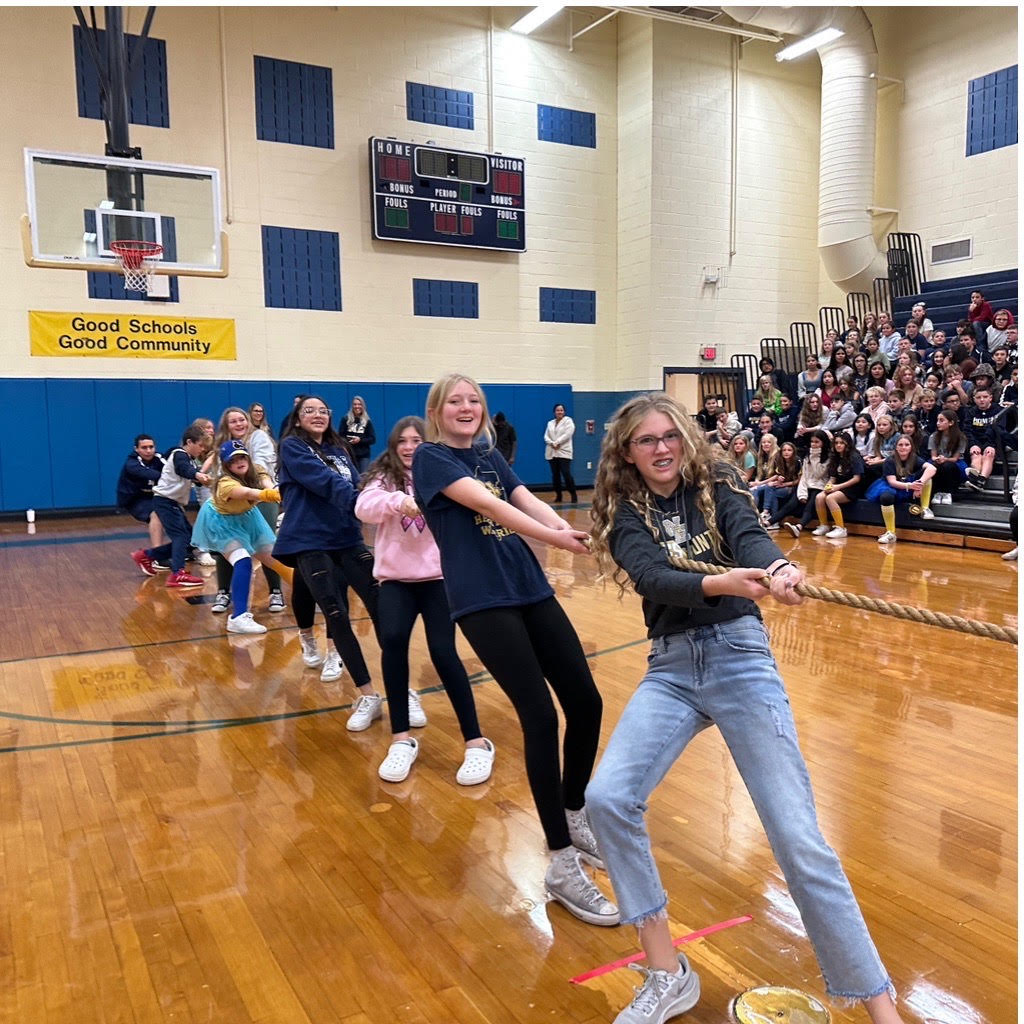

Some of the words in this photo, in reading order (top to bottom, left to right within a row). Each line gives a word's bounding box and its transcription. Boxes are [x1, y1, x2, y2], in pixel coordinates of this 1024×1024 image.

[377, 142, 411, 156] HOME
[490, 157, 523, 172] VISITOR
[389, 182, 414, 194] BONUS
[435, 188, 457, 199] PERIOD
[385, 197, 408, 208] FOULS
[490, 195, 513, 206] BONUS
[430, 202, 457, 214] PLAYER
[461, 205, 483, 216] FOULS
[497, 210, 518, 220] FOULS
[71, 317, 120, 333] Good
[129, 319, 198, 335] Schools
[58, 335, 107, 349] Good
[116, 336, 211, 354] Community
